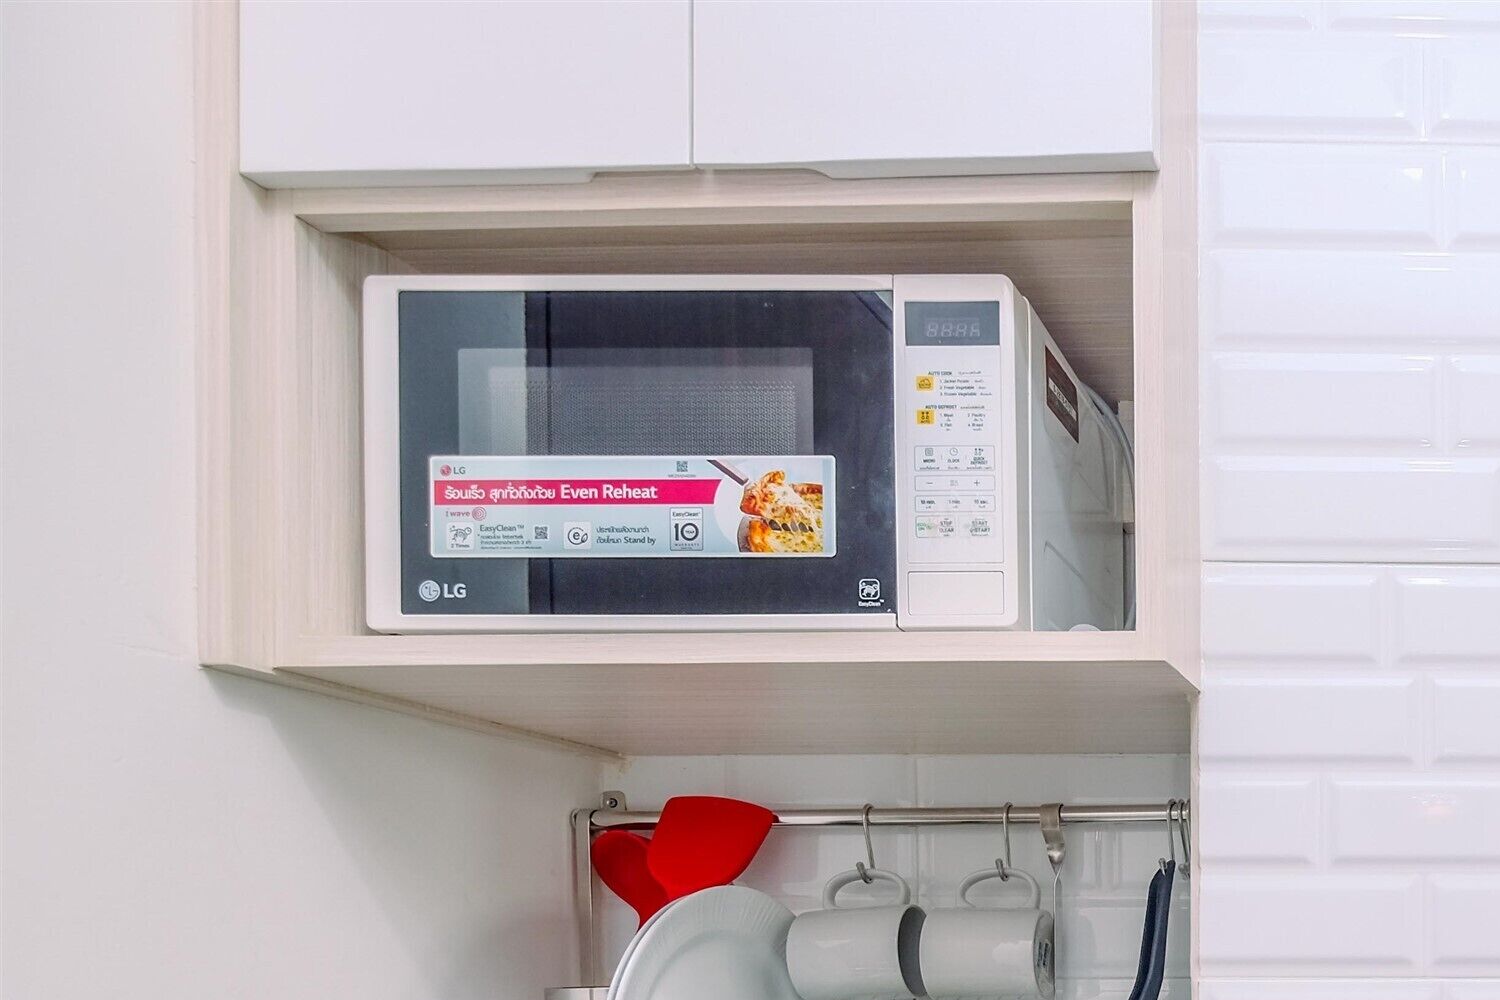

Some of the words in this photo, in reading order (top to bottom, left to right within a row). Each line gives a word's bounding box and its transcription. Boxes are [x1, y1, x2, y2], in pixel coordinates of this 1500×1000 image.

[453, 466, 466, 475] LG
[444, 484, 486, 500] ร้อนเร็ว
[560, 484, 599, 499] Even
[602, 484, 658, 499] Reheat
[674, 523, 699, 541] 10
[623, 536, 646, 544] Stand
[647, 536, 657, 546] by
[443, 583, 467, 599] LG
